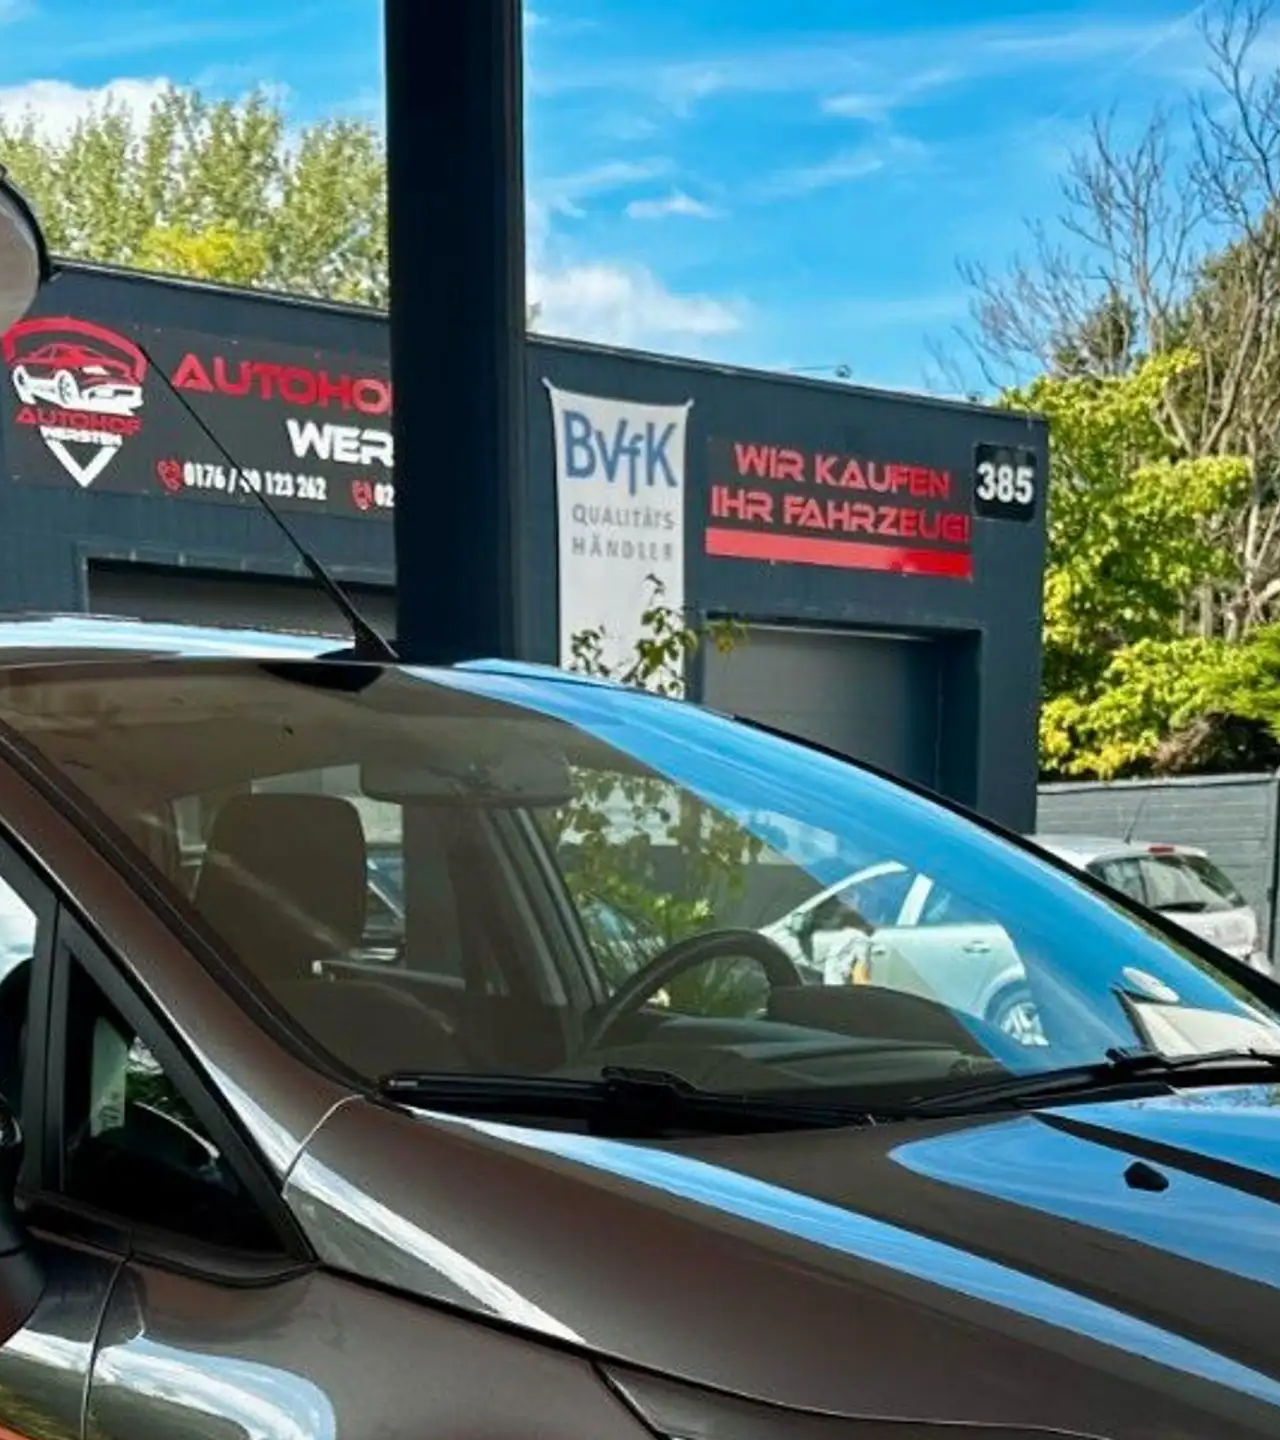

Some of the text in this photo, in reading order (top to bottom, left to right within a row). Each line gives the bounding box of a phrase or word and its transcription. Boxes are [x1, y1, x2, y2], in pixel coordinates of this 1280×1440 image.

[16, 406, 141, 436] AUTOHOF
[183, 461, 226, 489] 0176
[734, 443, 951, 498] WIR KAUFEN
[976, 461, 1034, 505] 385
[711, 485, 970, 543] IHR FAHRZEUG!
